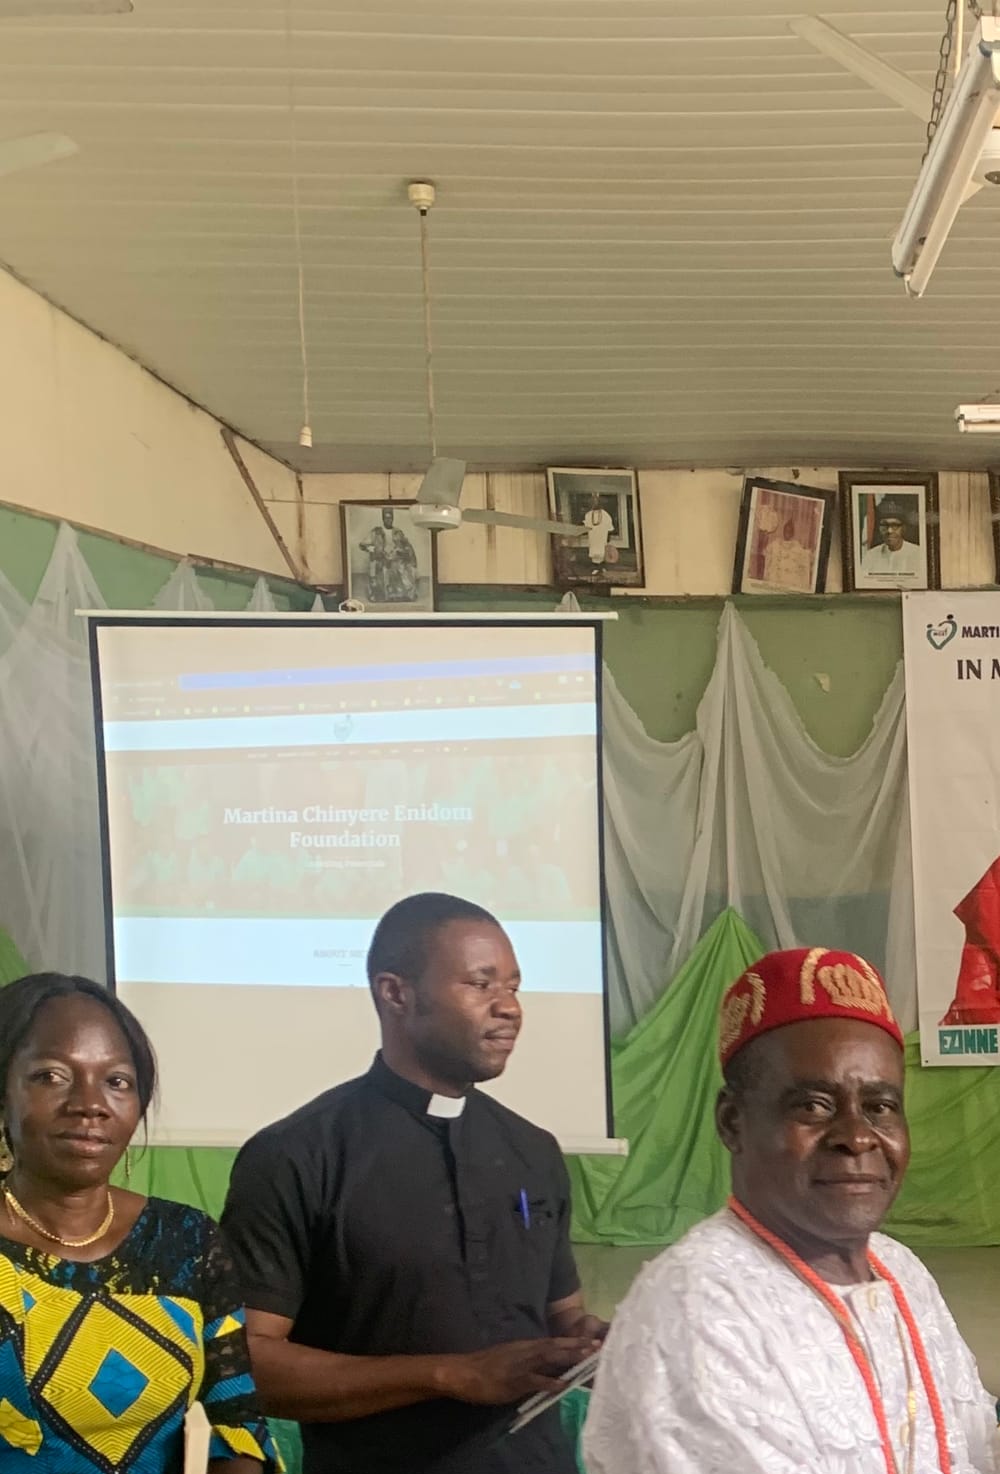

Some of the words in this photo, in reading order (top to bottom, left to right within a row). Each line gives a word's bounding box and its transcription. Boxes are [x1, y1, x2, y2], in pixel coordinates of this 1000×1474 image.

[956, 659, 982, 680] IN
[223, 807, 299, 824] Martina
[302, 805, 389, 826] Chinyere
[394, 803, 473, 822] Enidom
[290, 830, 401, 849] Foundation
[939, 1029, 998, 1055] EZINNE
